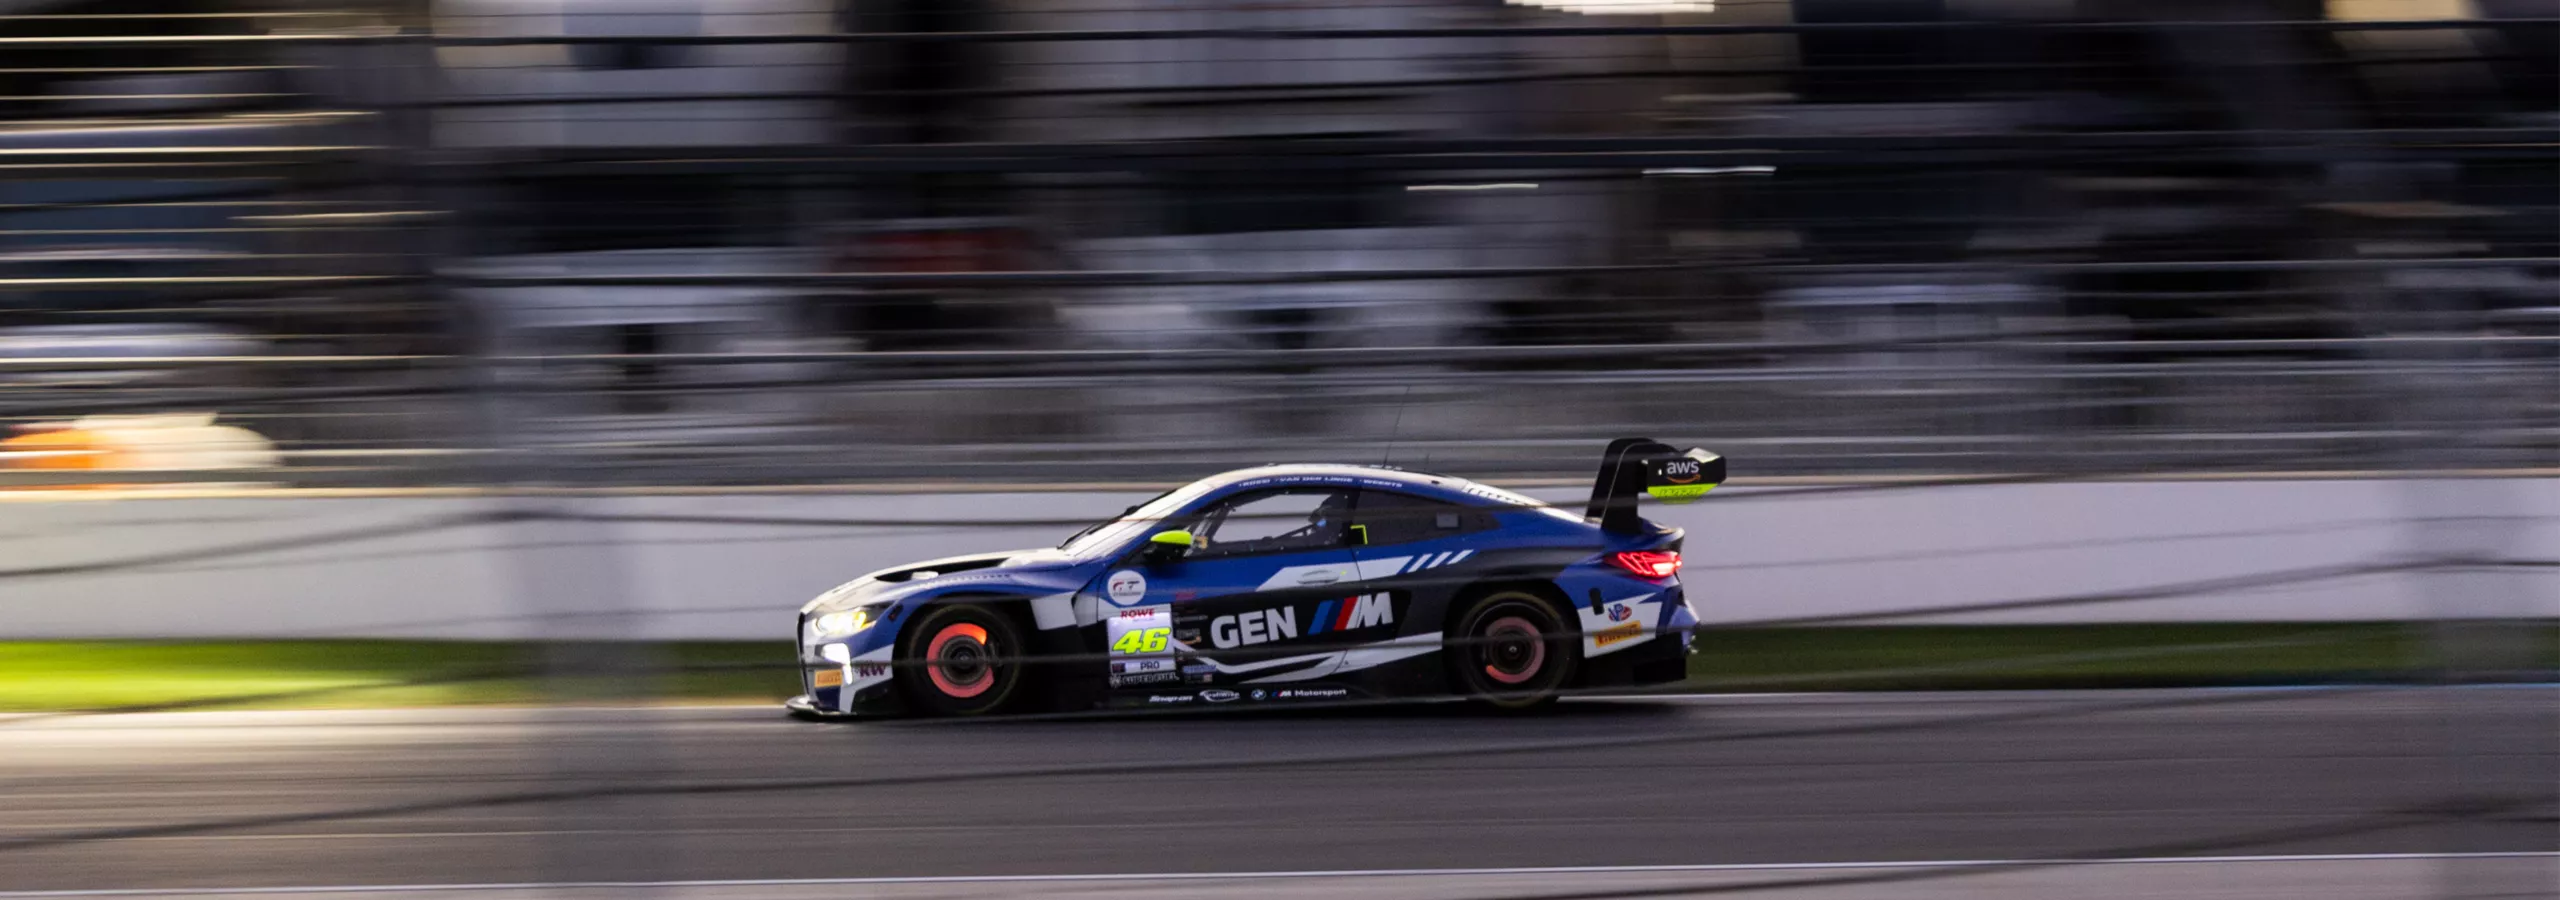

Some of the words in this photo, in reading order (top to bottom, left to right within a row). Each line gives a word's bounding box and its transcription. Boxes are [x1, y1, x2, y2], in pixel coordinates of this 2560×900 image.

[1667, 461, 1700, 474] aws
[1121, 608, 1155, 618] ROWE
[1210, 605, 1298, 649] GEN
[1345, 591, 1394, 630] M
[1112, 627, 1171, 654] 46
[1140, 661, 1160, 670] PRO
[1295, 689, 1347, 698] Motorsport
